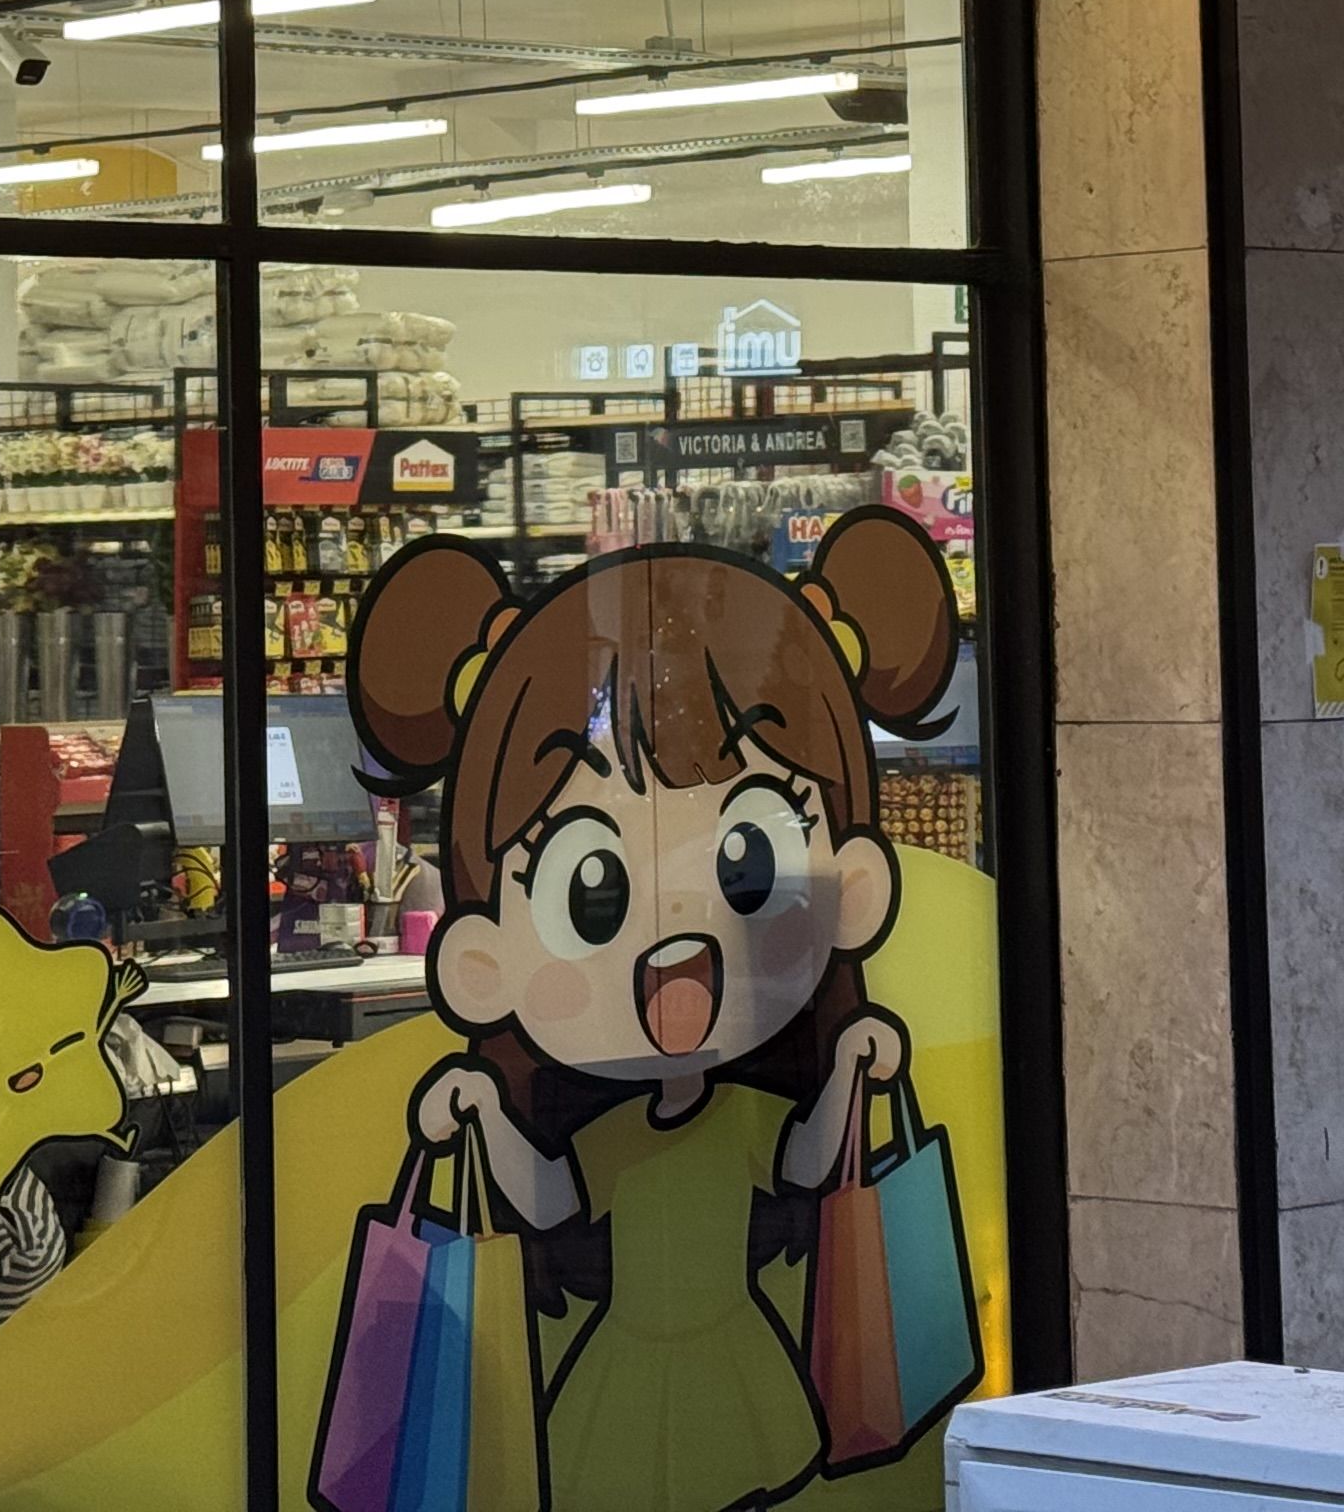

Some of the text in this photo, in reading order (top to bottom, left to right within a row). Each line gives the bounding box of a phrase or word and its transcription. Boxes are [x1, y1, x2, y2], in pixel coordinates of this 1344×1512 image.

[678, 429, 826, 456] VICTORIA & ANDREA
[399, 458, 450, 478] Pattex
[788, 515, 825, 544] HA
